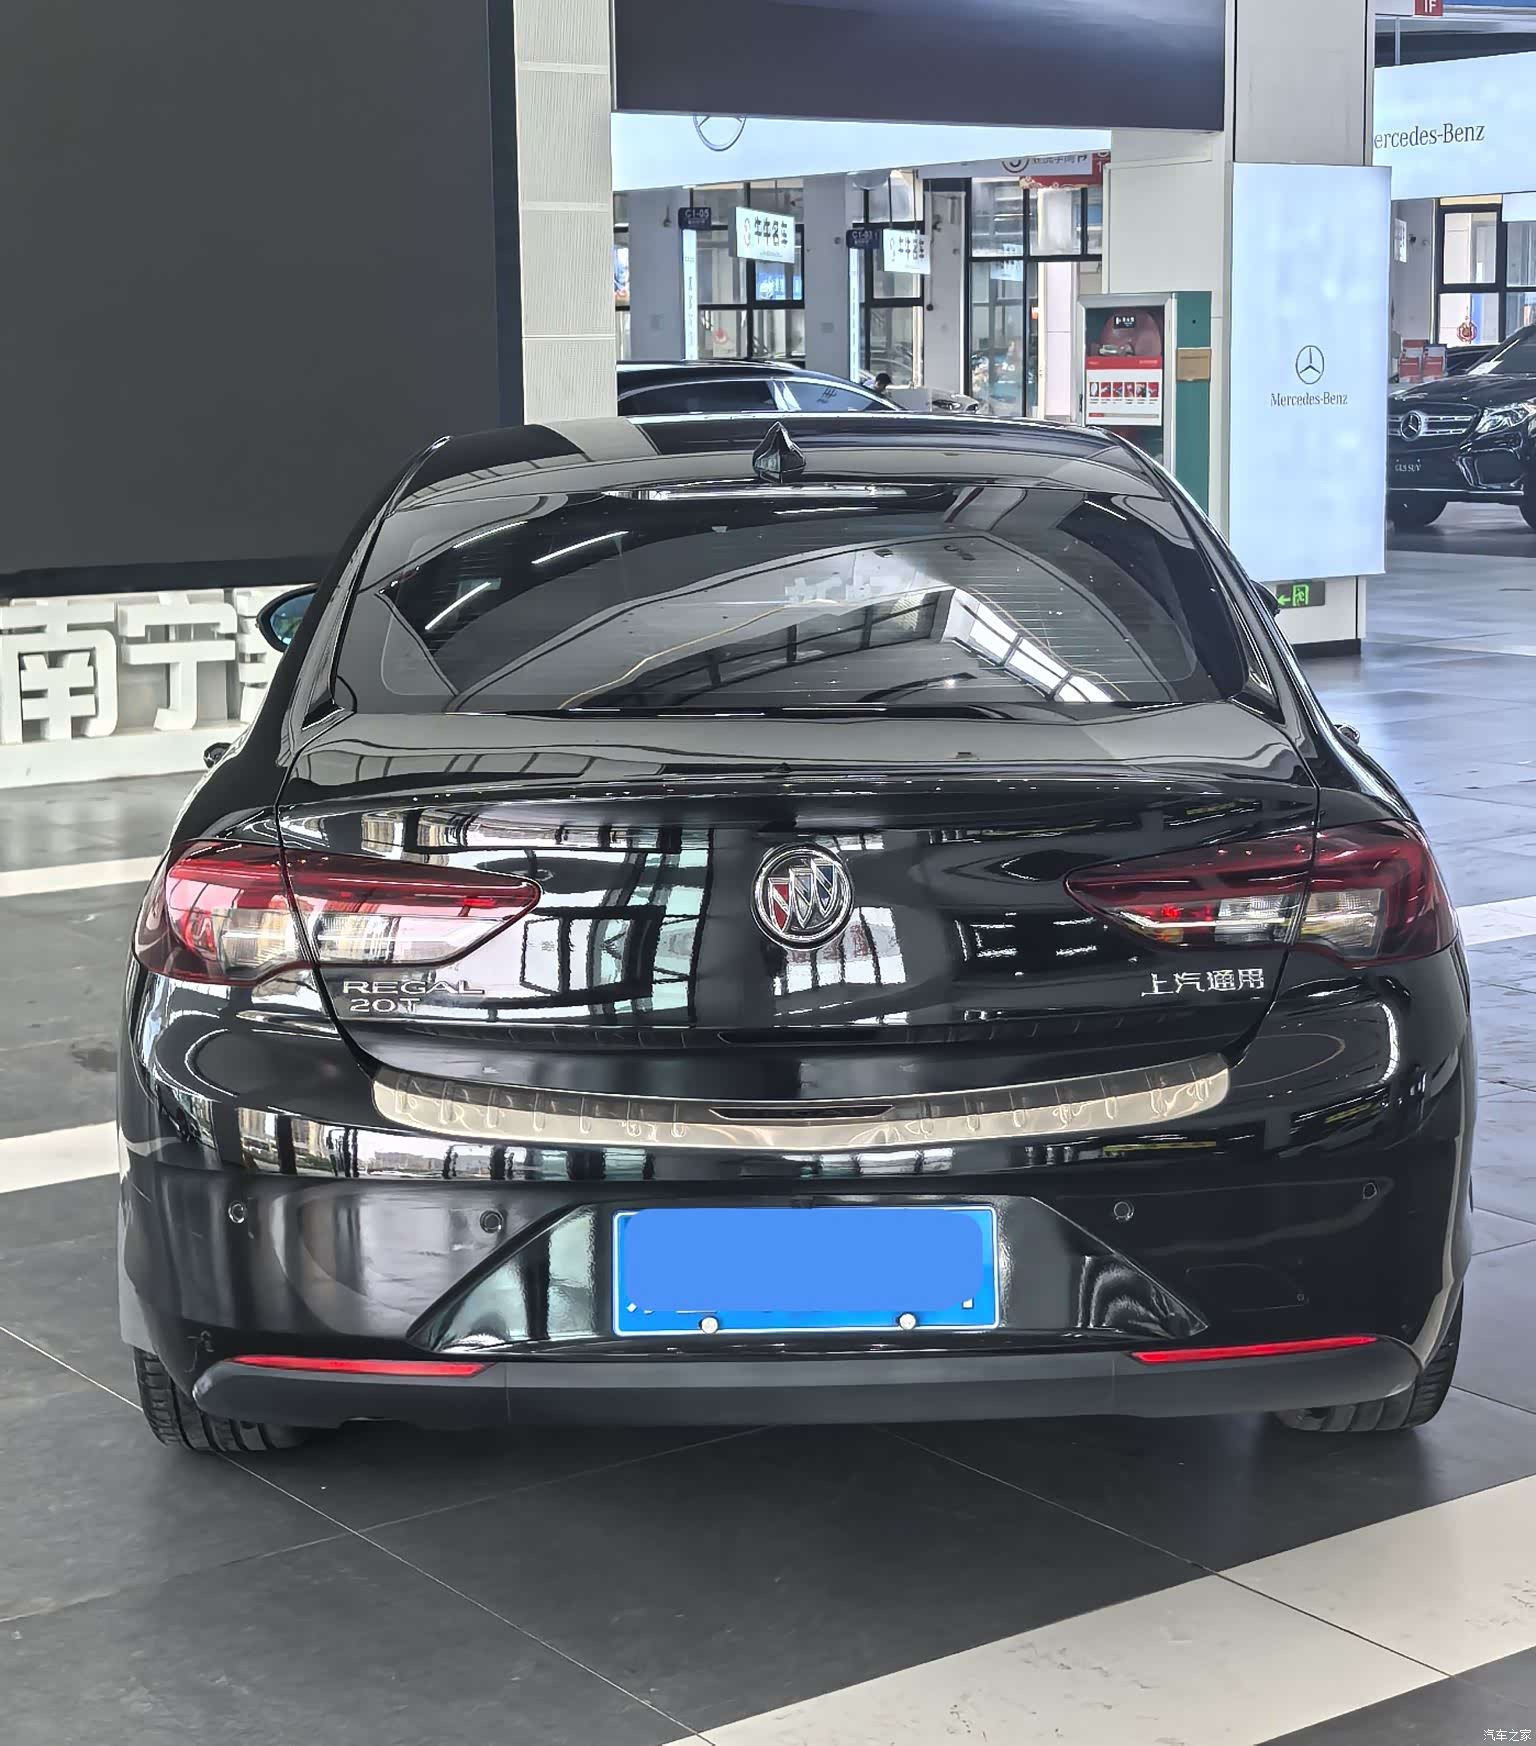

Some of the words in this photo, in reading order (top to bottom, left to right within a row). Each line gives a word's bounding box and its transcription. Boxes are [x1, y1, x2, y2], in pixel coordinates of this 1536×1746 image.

[1374, 122, 1486, 150] ercedes-Benz
[1270, 391, 1349, 407] Mercedes-Benz
[0, 587, 284, 745] 南宁
[342, 980, 486, 995] REGAL
[1141, 968, 1265, 997] 上汽通用
[350, 998, 421, 1013] 20T
